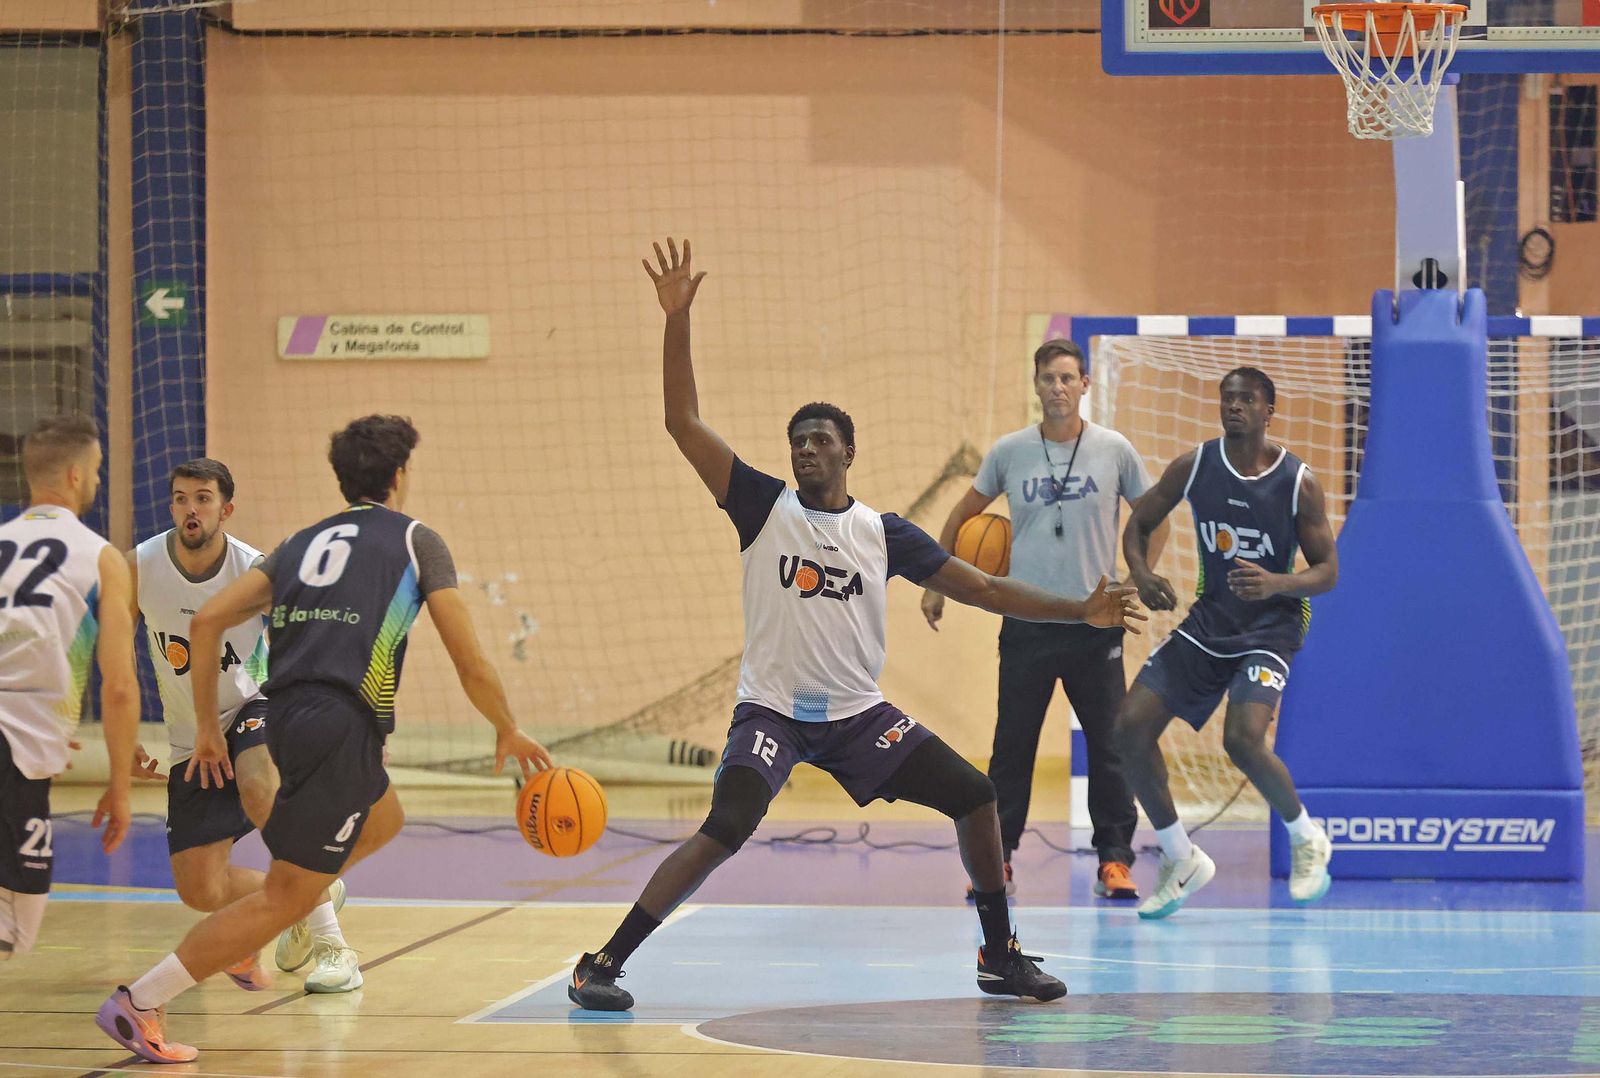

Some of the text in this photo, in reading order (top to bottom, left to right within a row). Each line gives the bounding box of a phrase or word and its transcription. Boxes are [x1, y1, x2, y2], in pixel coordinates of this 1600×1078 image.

[329, 321, 465, 336] Cabina de Control
[330, 342, 338, 353] y
[298, 523, 360, 587] 6
[1200, 520, 1274, 559] UDEA
[779, 554, 863, 602] UDEA
[153, 631, 242, 676] UDA
[752, 730, 779, 767] 12
[335, 812, 361, 842] 6
